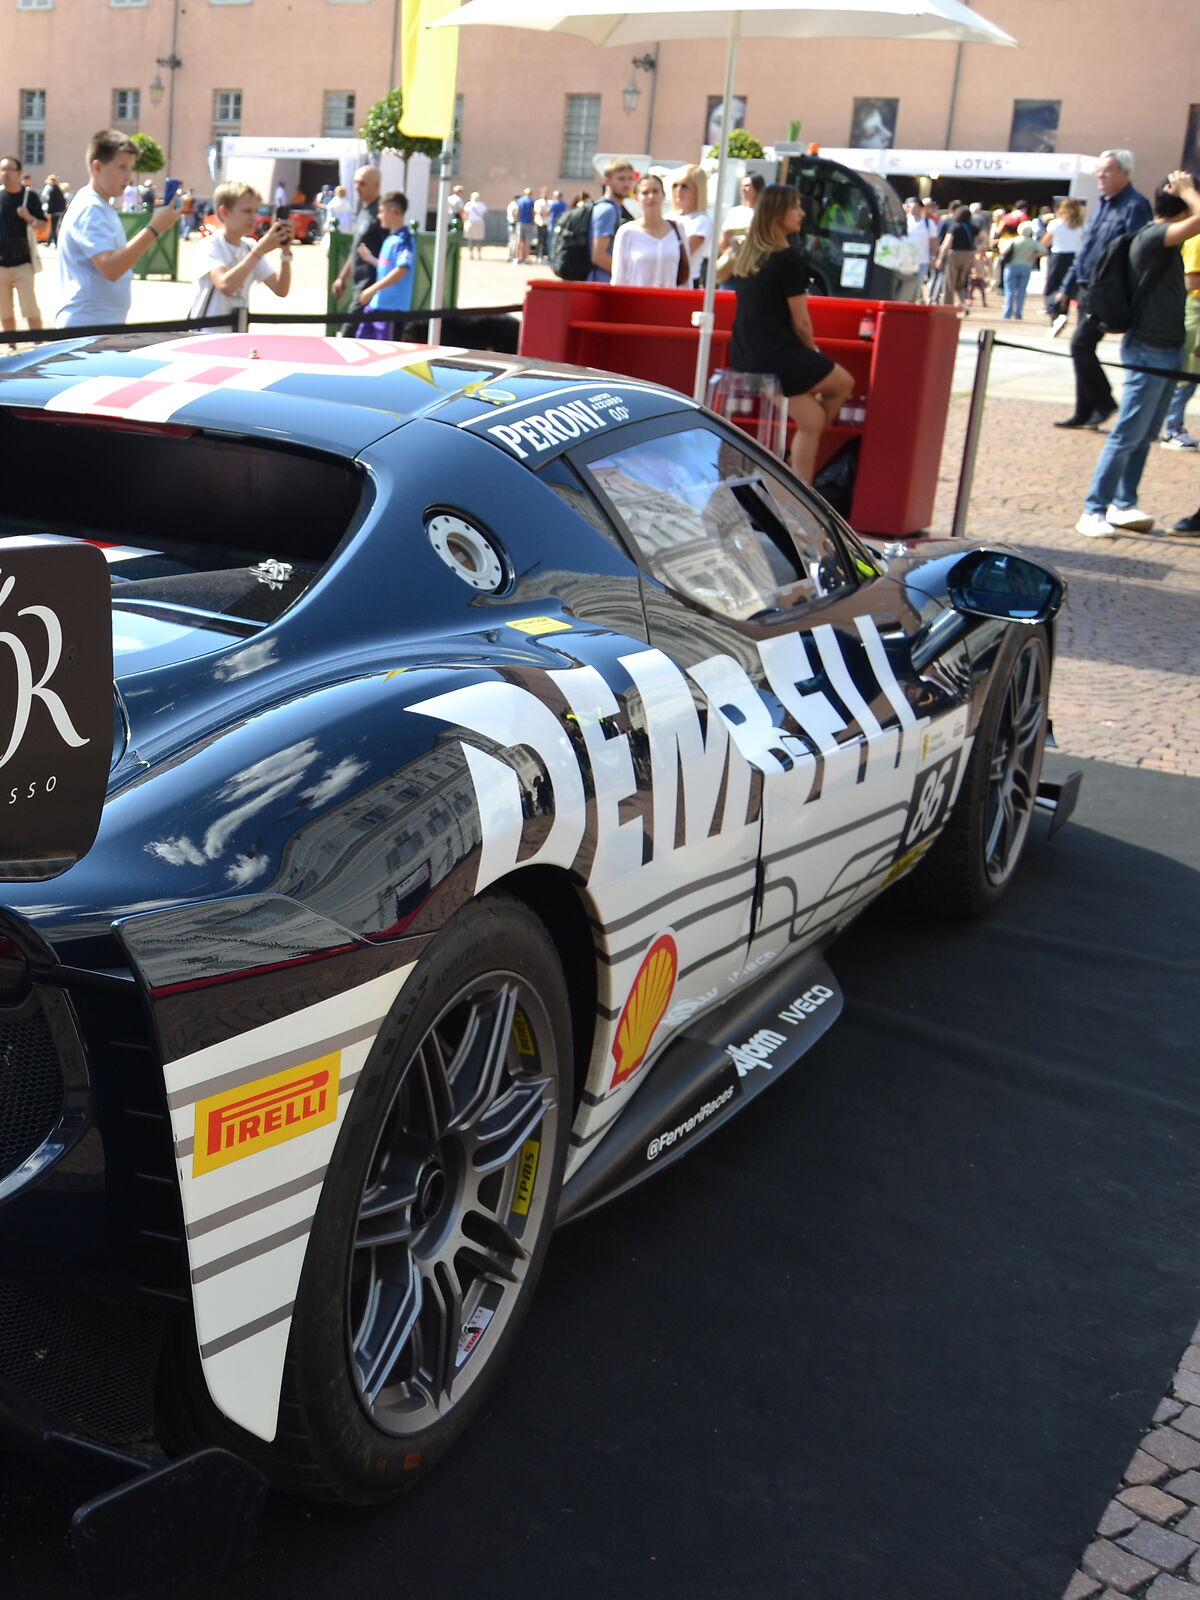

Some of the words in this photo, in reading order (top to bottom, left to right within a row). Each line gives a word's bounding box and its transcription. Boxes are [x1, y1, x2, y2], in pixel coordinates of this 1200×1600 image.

[955, 158, 1003, 170] LOTUS
[487, 400, 607, 459] PERONI
[906, 756, 954, 846] 86
[778, 984, 835, 1025] IVECO
[207, 1070, 330, 1156] PIRELLI
[646, 1085, 735, 1160] @FerrariRaces
[517, 1151, 535, 1202] TPMS
